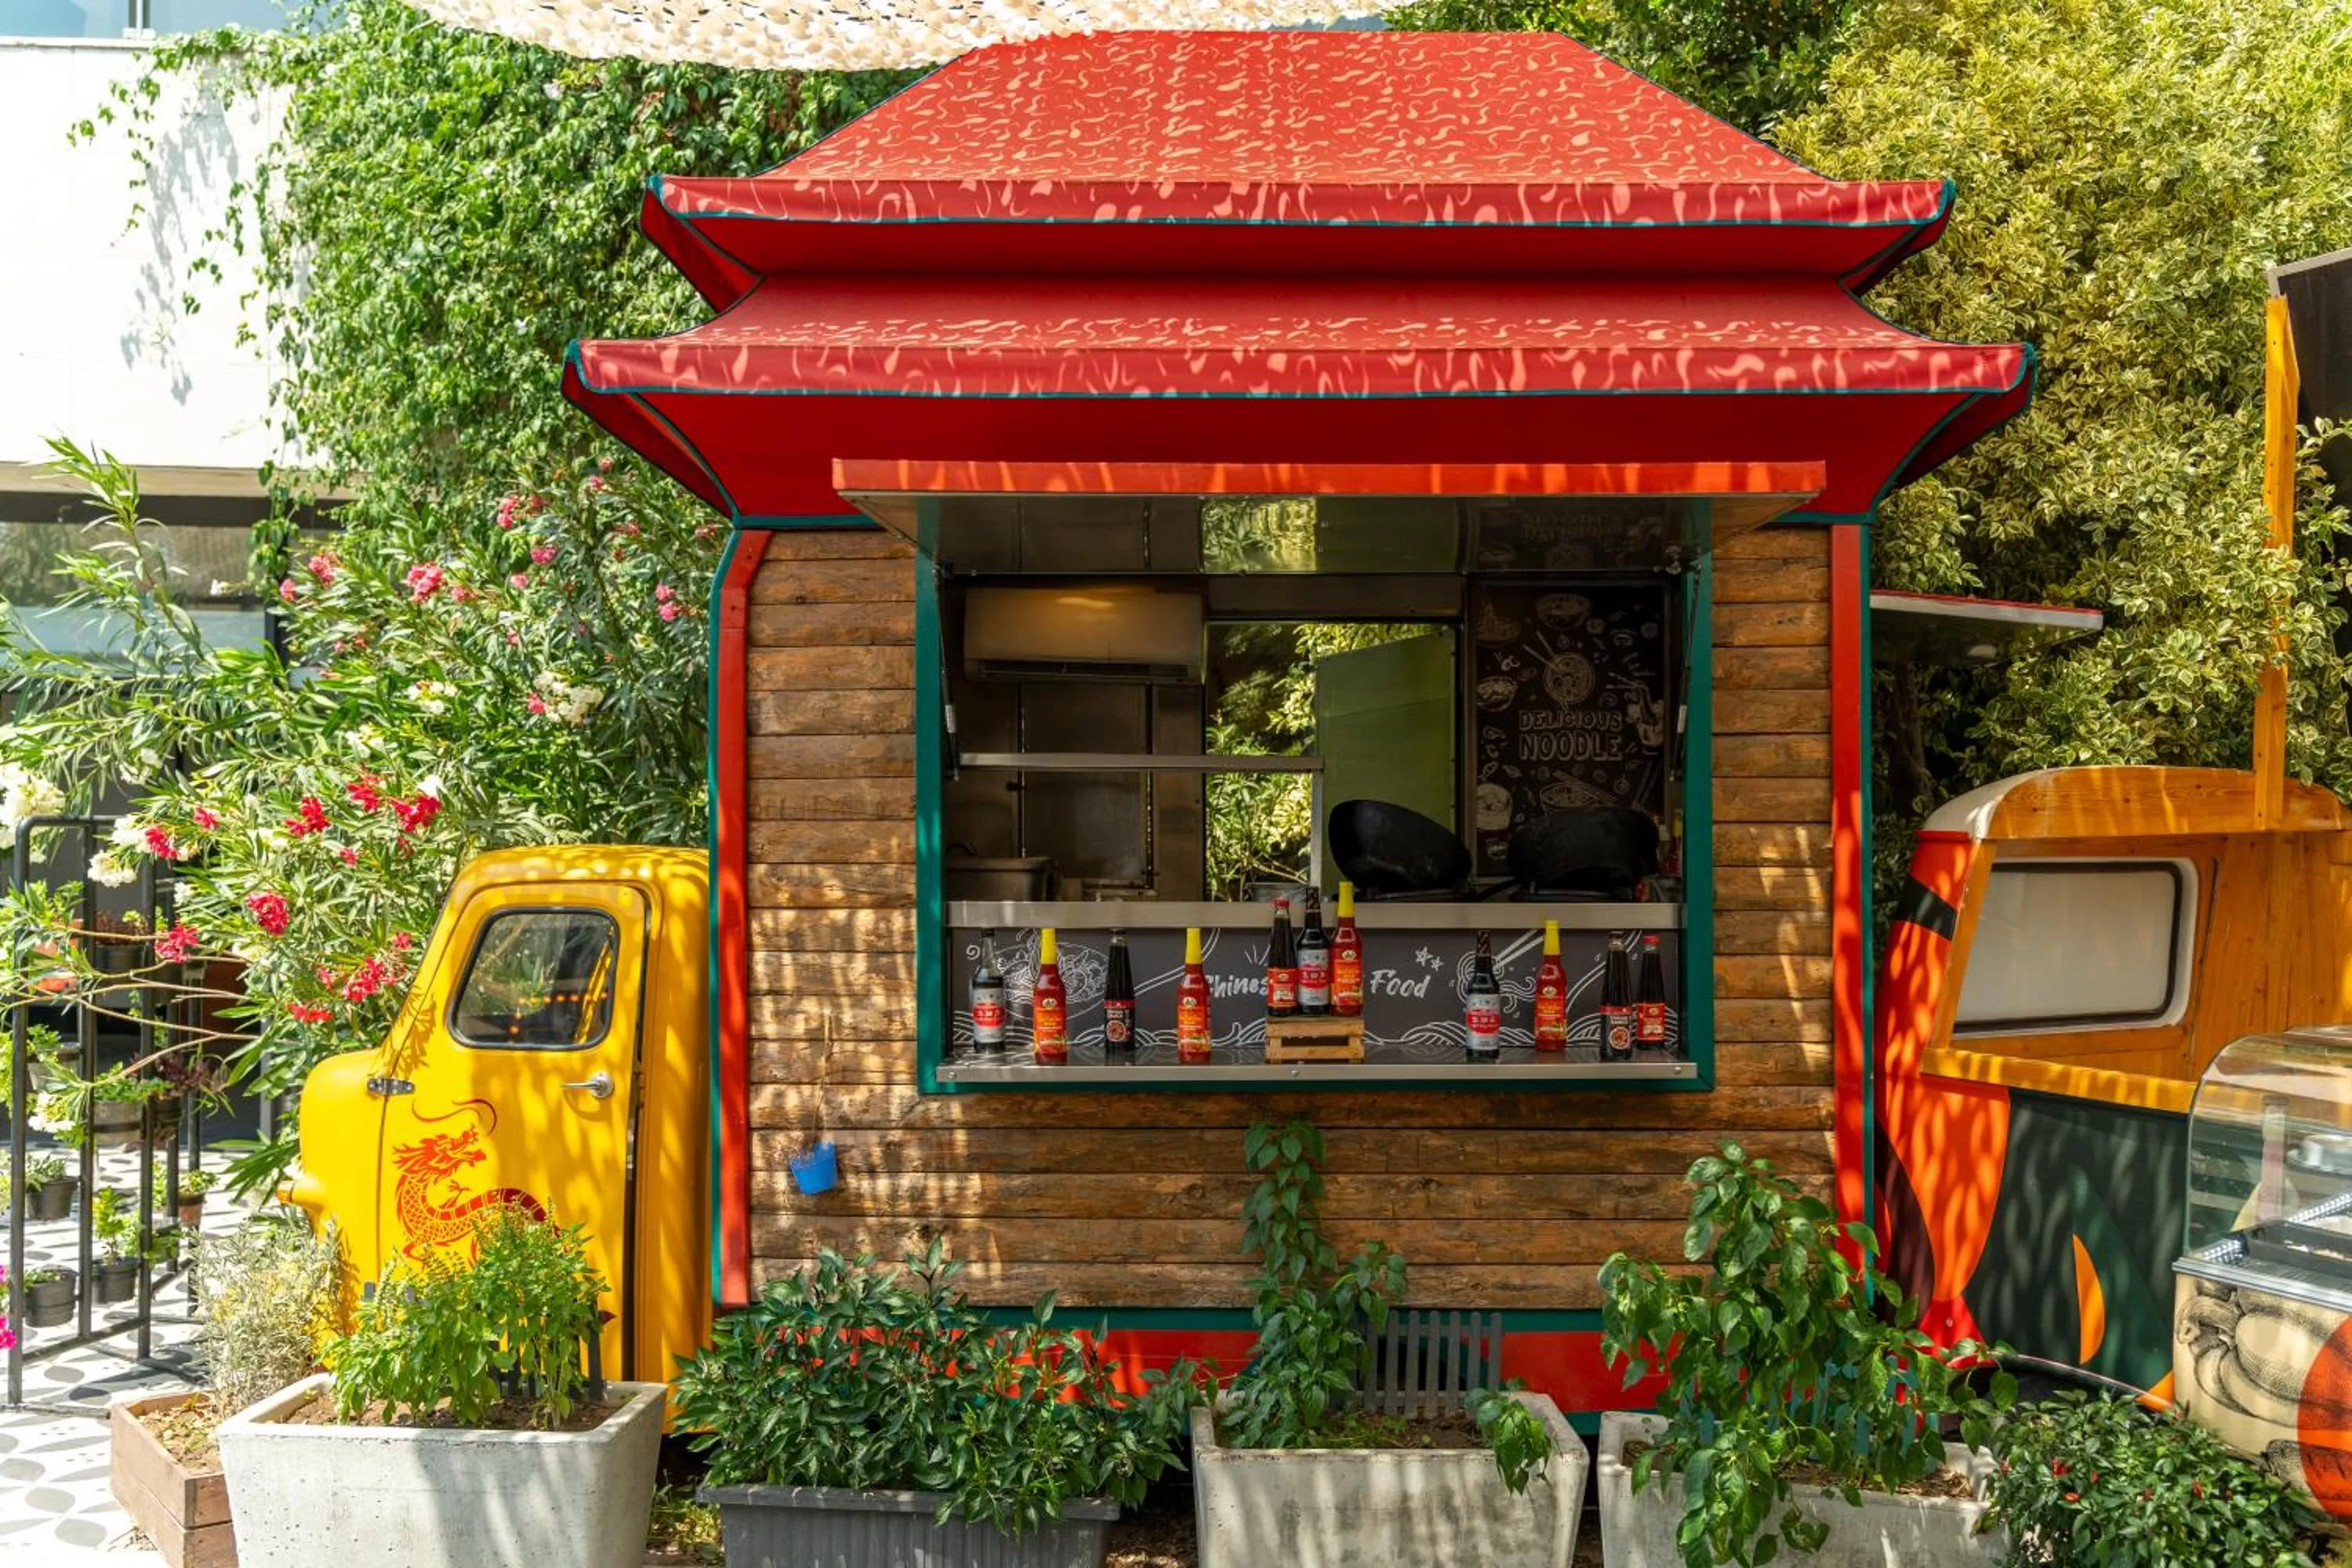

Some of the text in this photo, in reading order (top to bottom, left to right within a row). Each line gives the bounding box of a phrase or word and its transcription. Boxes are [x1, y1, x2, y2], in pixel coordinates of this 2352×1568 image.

[1519, 709, 1623, 731] DELICIOUS
[1519, 730, 1623, 761] NOODLE
[1370, 969, 1432, 998] Food
